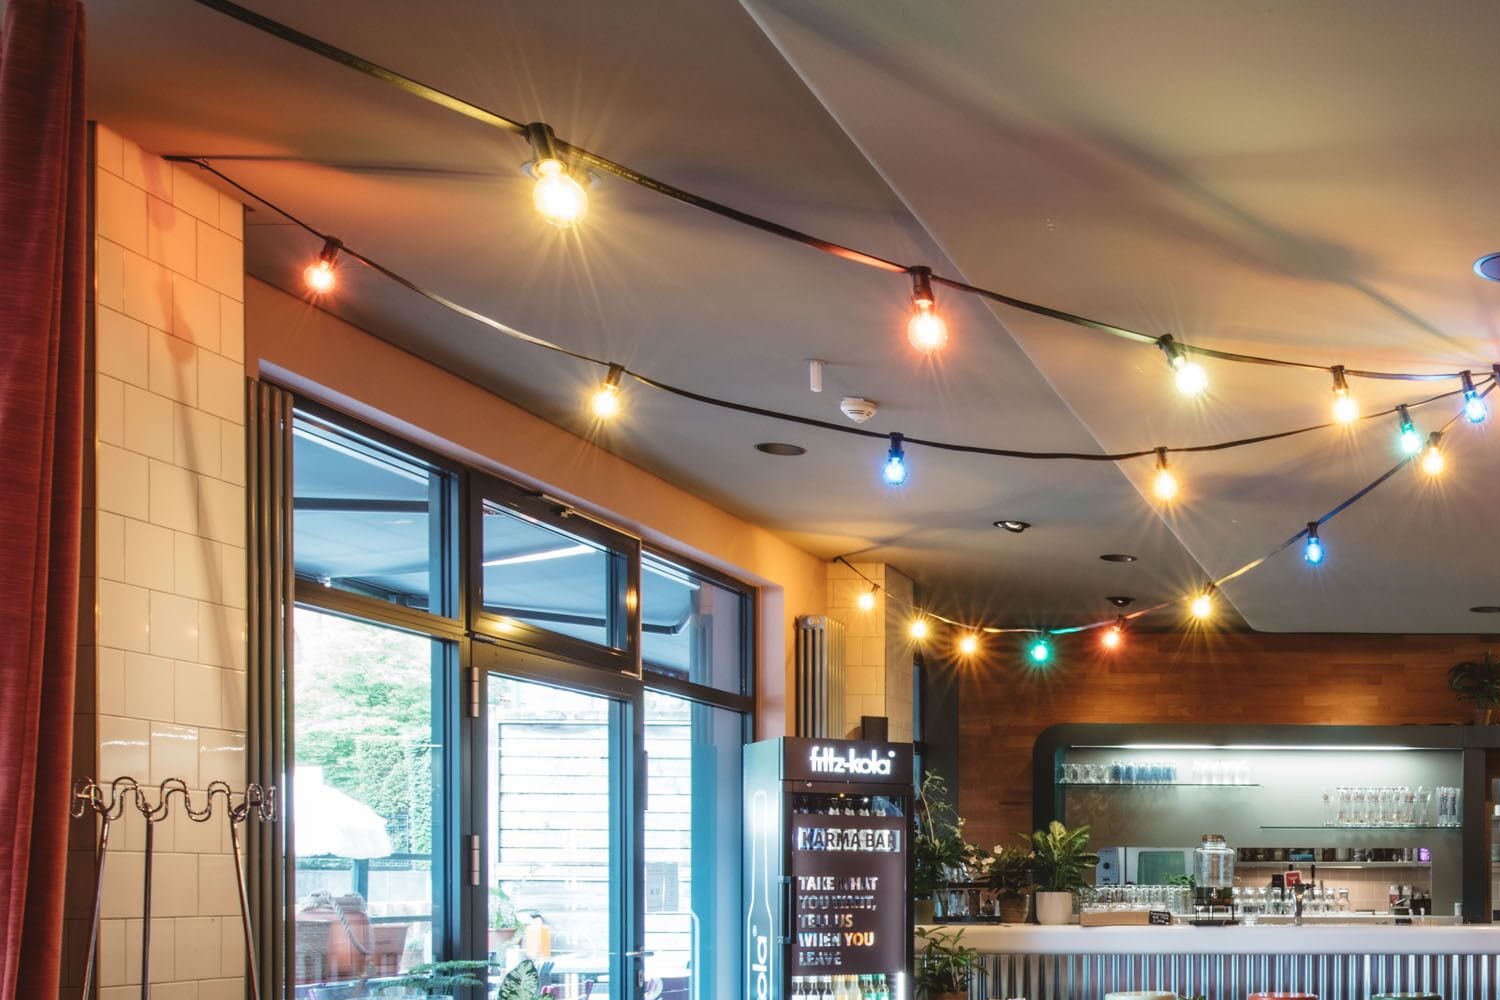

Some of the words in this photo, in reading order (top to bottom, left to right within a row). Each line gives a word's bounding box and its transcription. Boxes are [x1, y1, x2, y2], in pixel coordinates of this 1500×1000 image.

[802, 831, 861, 849] KARMA
[865, 832, 897, 850] BAR
[798, 876, 834, 891] TAKE
[799, 895, 829, 909] YOU
[834, 914, 853, 928] US
[798, 932, 841, 947] WHEN
[844, 932, 874, 947] YOU
[799, 951, 842, 966] LEAVE
